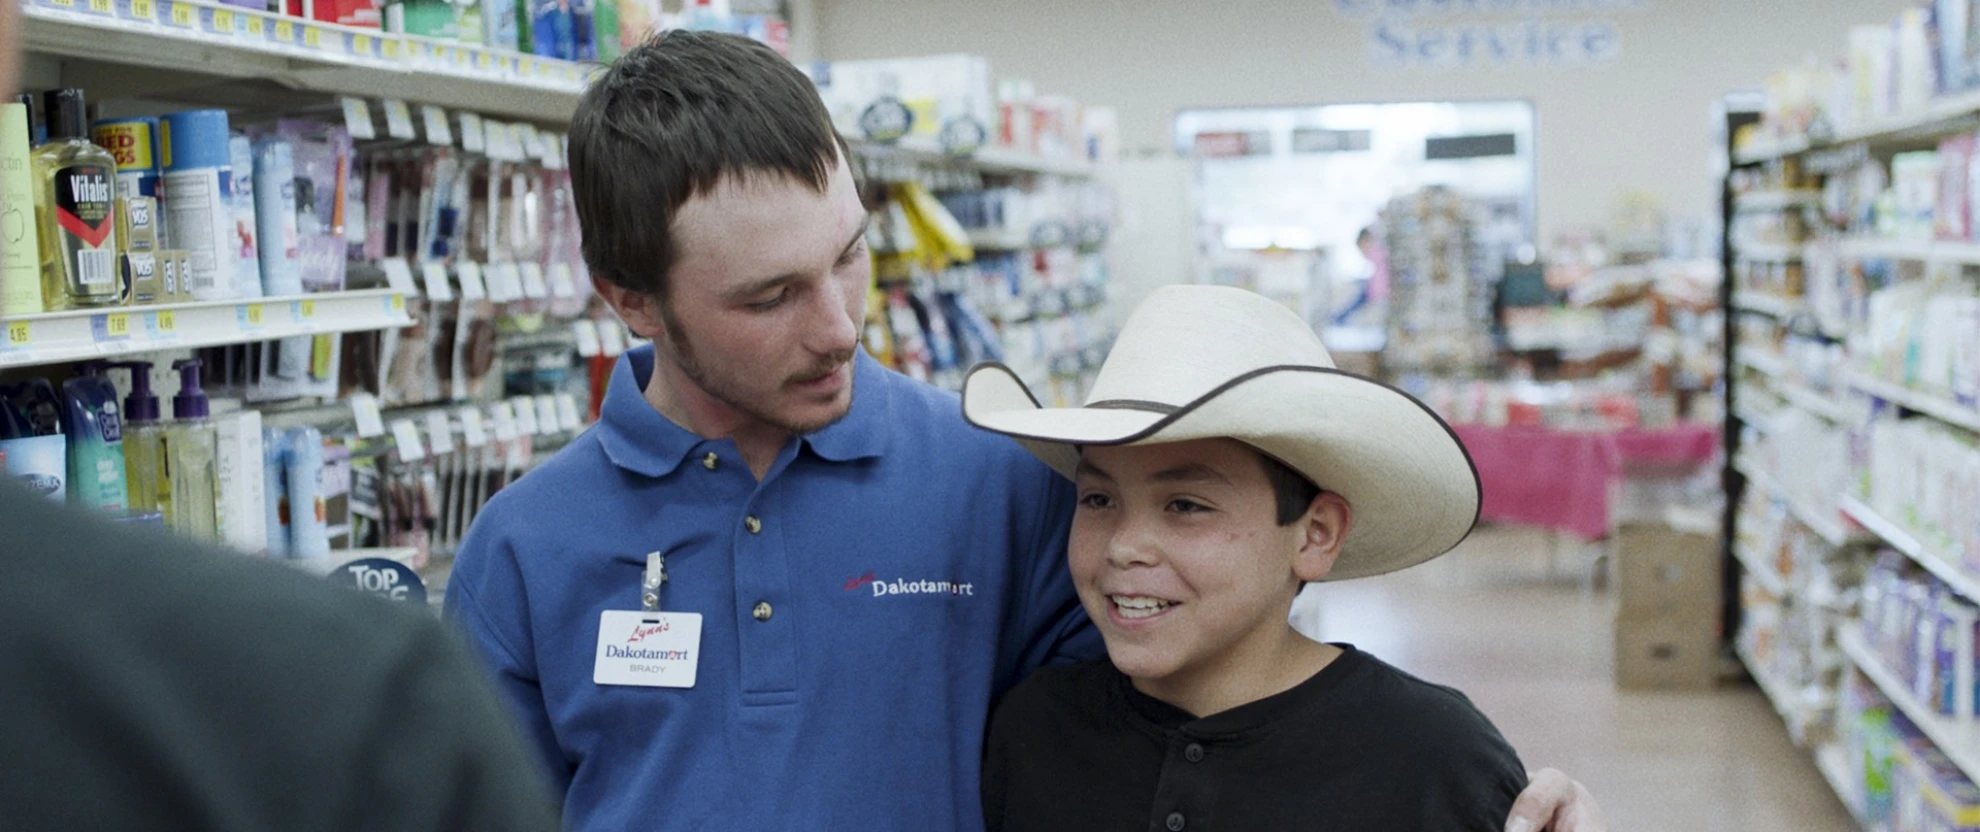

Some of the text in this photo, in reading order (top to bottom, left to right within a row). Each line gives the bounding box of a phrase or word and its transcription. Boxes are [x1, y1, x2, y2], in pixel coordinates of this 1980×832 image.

[1372, 20, 1618, 65] Service
[70, 174, 108, 203] Vitalis
[348, 565, 399, 591] TOP
[627, 617, 670, 642] Lynn's
[629, 663, 667, 674] BRADY
